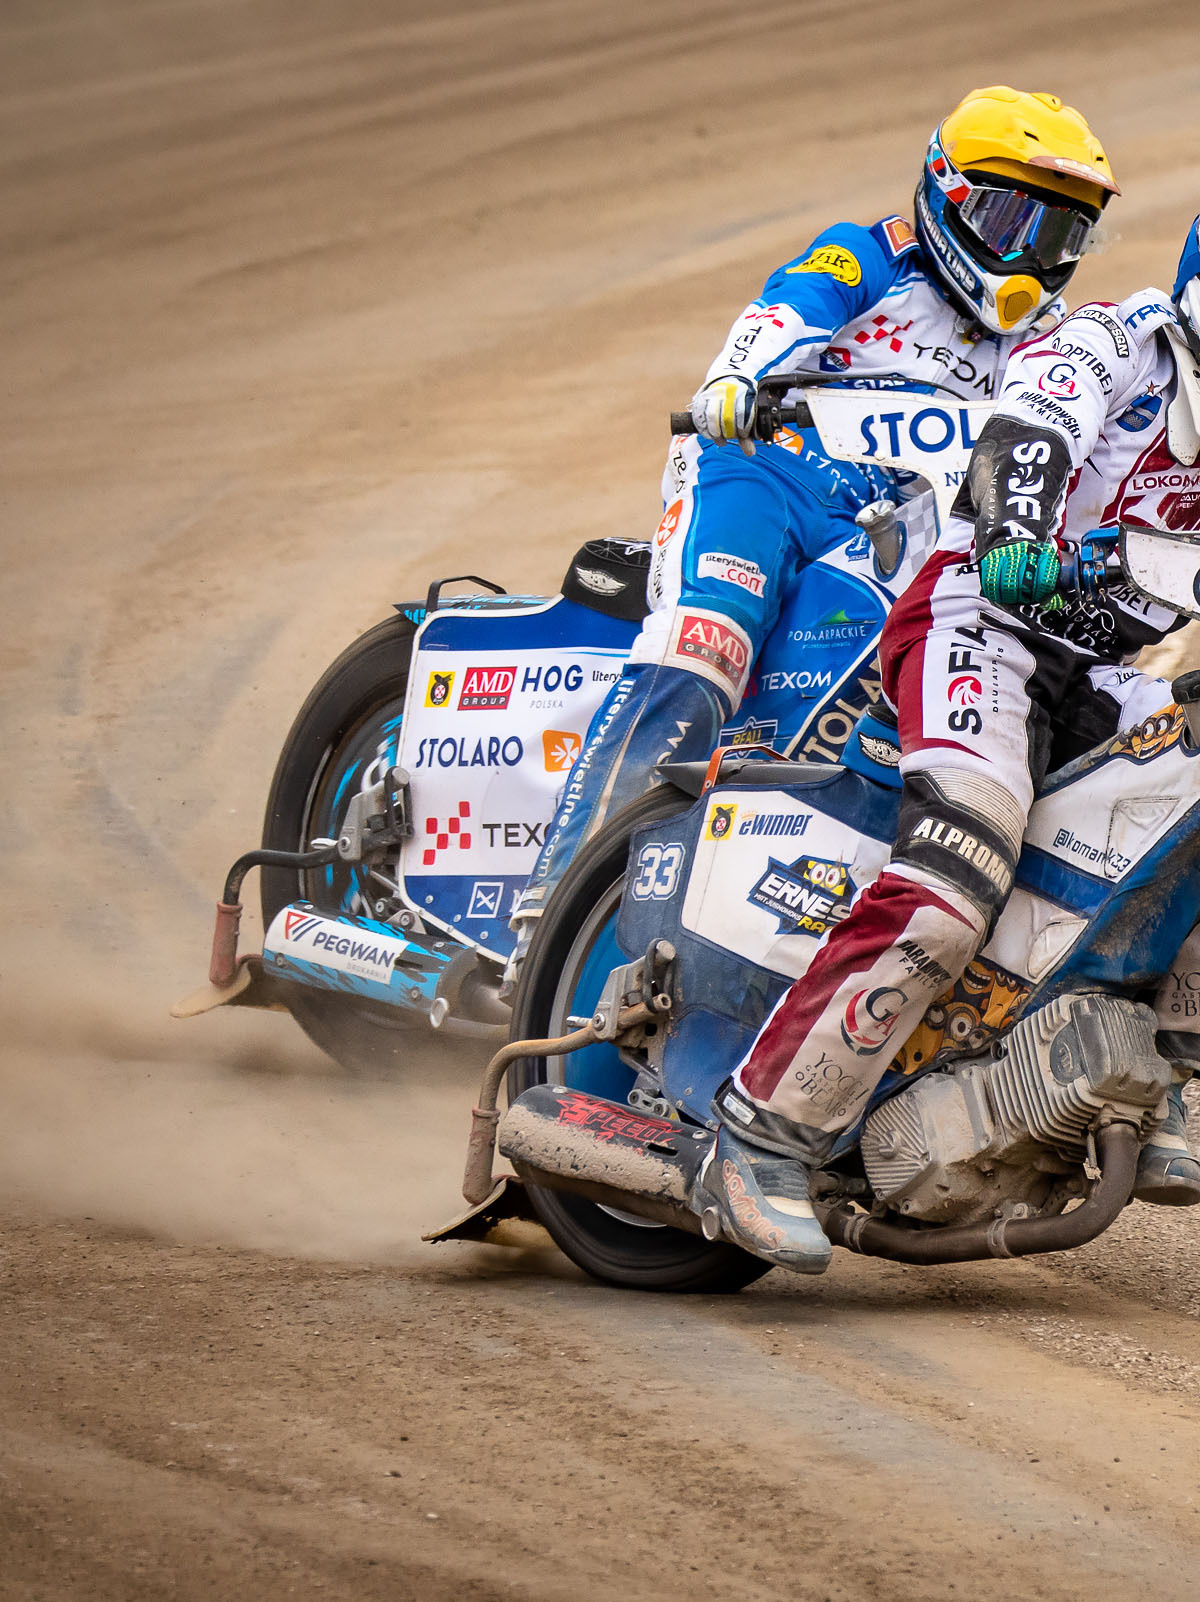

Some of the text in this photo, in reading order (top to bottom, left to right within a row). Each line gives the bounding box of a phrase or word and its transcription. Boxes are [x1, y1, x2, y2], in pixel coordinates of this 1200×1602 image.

[683, 621, 746, 669] AMD
[684, 643, 740, 679] GROUP
[464, 671, 514, 695] AMD
[520, 664, 584, 693] HOG
[760, 671, 832, 691] TEXOM
[462, 697, 506, 706] GROUP
[416, 735, 524, 769] STOLARO
[633, 844, 685, 900] 33
[312, 931, 396, 969] PEGWAN
